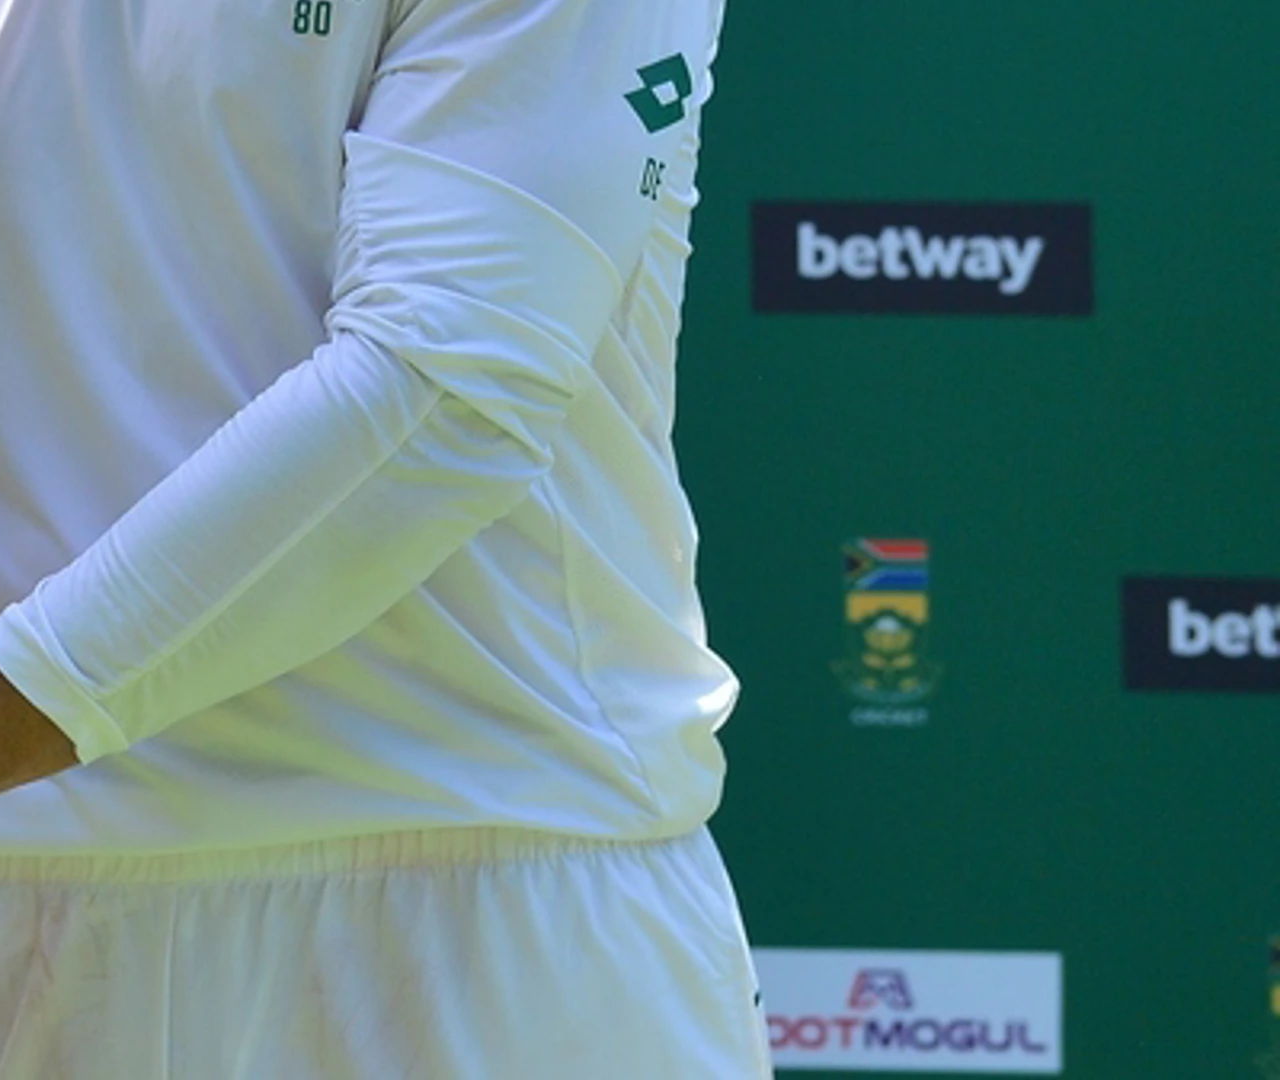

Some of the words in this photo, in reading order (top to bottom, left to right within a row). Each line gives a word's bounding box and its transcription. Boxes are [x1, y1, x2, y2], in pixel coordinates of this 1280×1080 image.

[797, 222, 1044, 294] betway
[1168, 598, 1280, 658] bet
[767, 1014, 1047, 1054] OOTMOGUL
